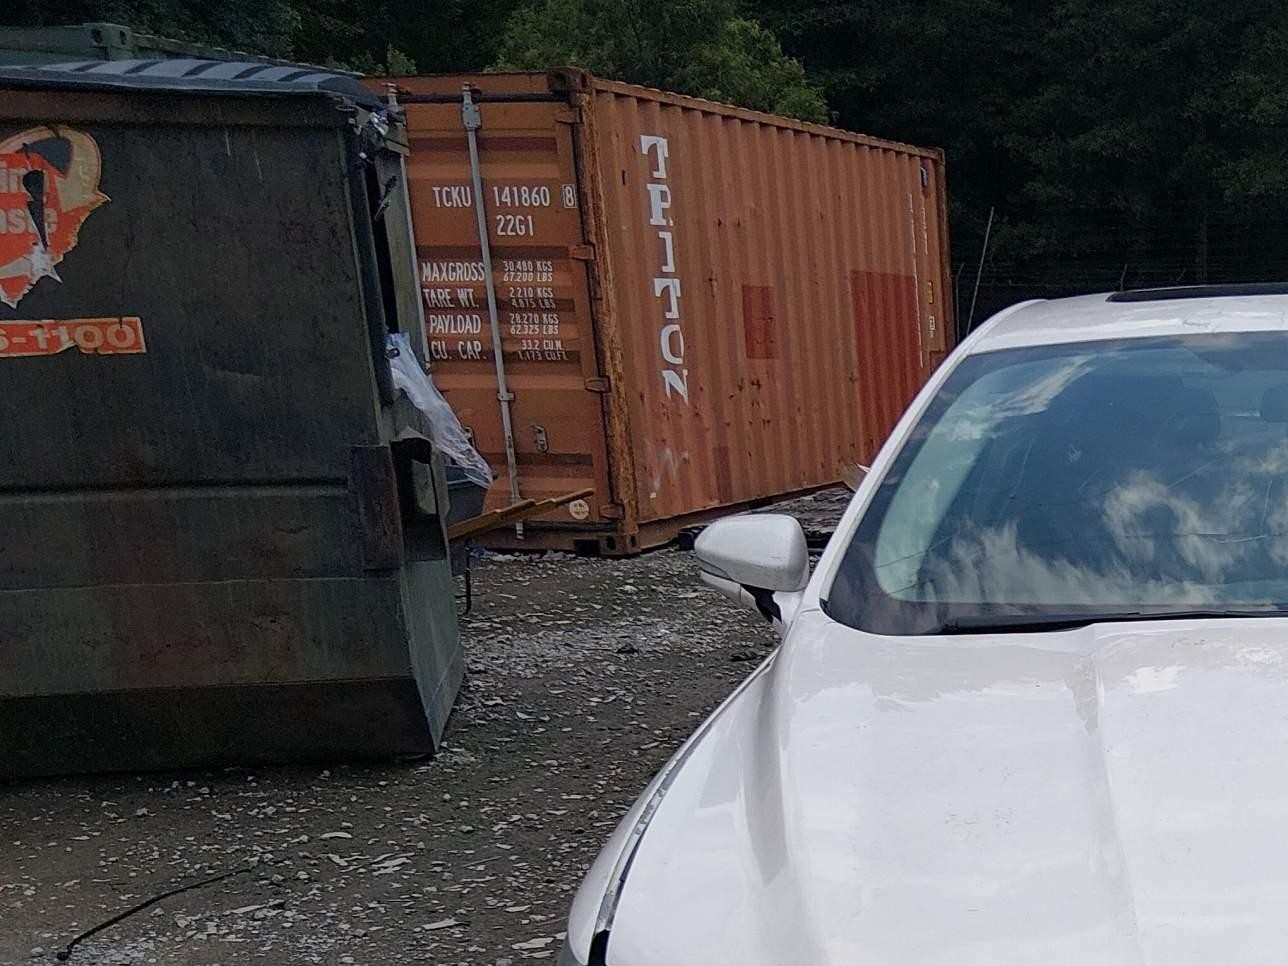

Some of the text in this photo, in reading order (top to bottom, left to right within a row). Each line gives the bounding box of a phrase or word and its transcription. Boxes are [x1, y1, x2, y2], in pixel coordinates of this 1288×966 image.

[432, 185, 576, 208] TCKU 141860 8
[496, 215, 534, 237] 22G1
[422, 262, 485, 281] MAXGROSS
[536, 260, 553, 272] KGS
[640, 135, 689, 405] TRITON
[536, 272, 553, 282] LBS
[422, 288, 480, 308] TARE WT.
[536, 287, 554, 298] KGS
[538, 299, 557, 309] LBS
[429, 314, 482, 334] PAYLOAD
[542, 313, 559, 324] KGS
[543, 324, 559, 335] LBS
[431, 340, 488, 360] CU. CAP.
